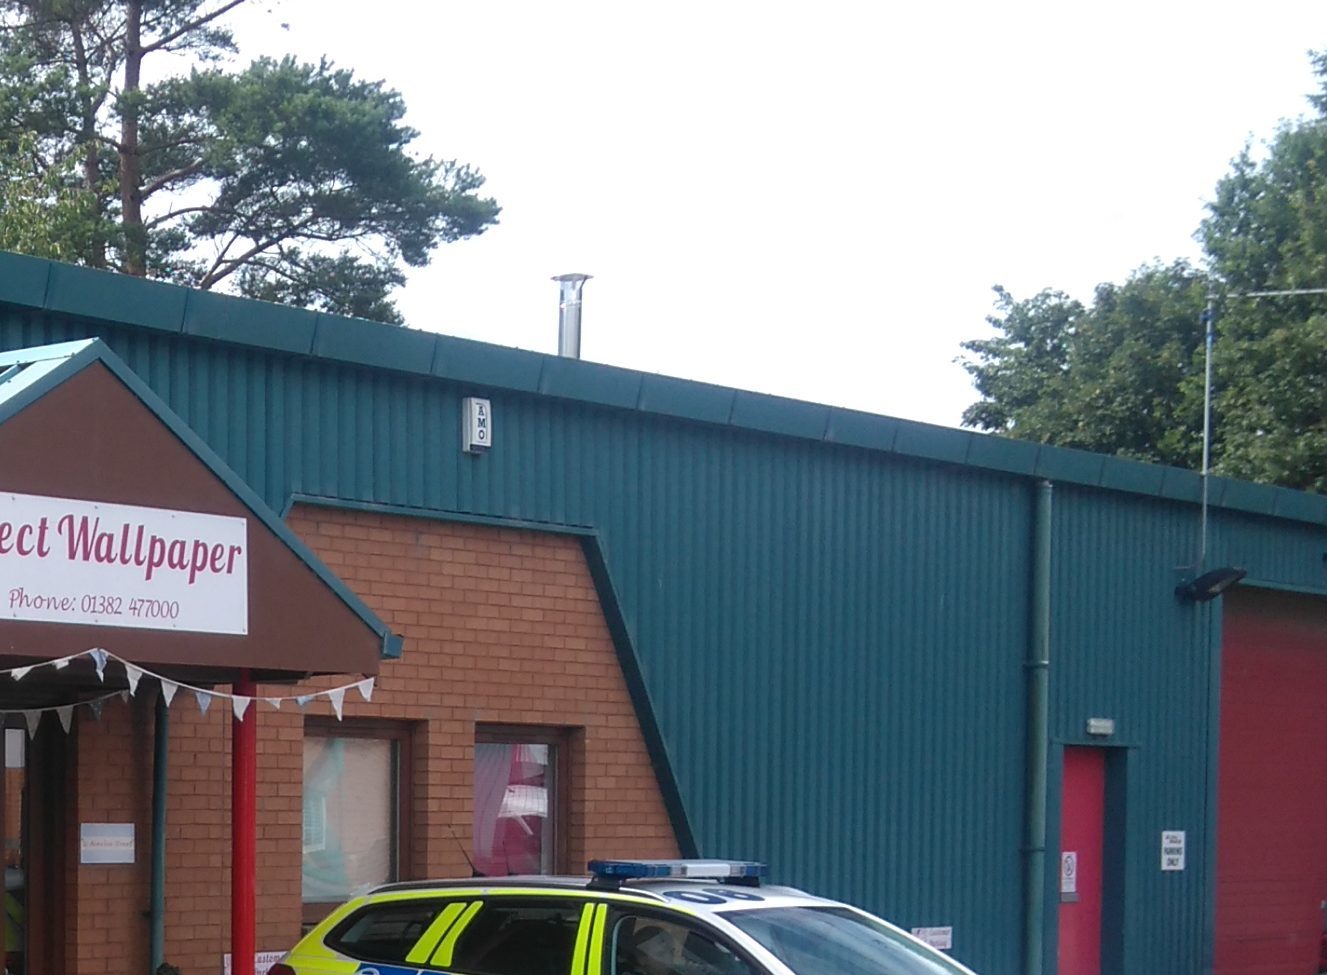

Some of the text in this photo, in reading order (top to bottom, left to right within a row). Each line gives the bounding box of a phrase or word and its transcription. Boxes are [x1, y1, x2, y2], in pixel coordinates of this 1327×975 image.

[58, 514, 242, 585] Wallpaper
[9, 587, 180, 619] Phone: 01382 477000
